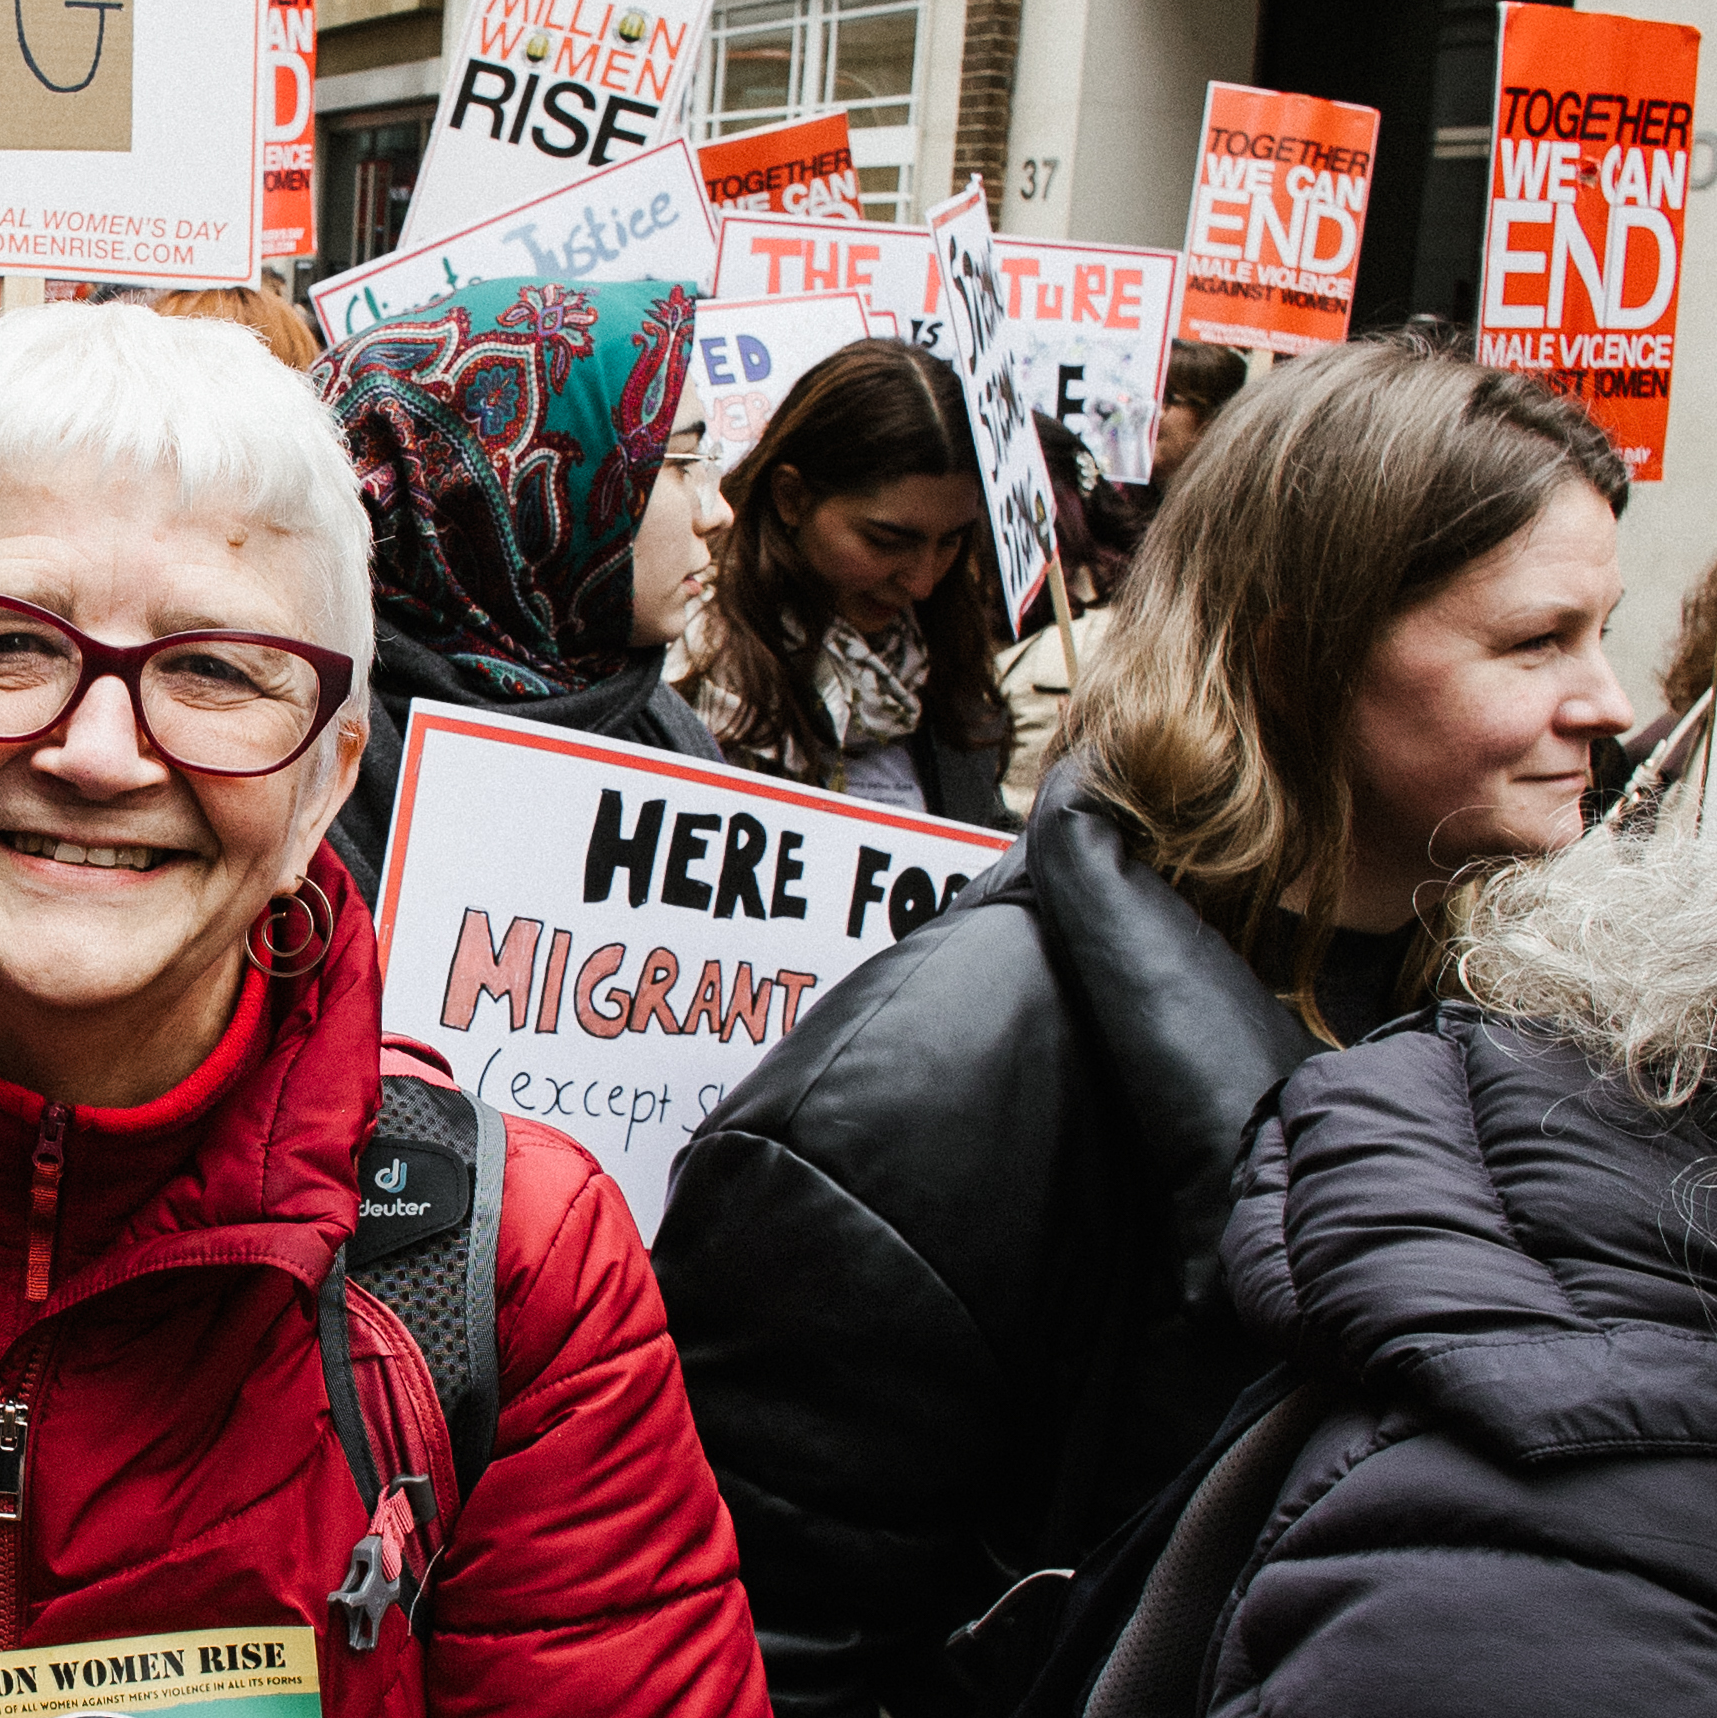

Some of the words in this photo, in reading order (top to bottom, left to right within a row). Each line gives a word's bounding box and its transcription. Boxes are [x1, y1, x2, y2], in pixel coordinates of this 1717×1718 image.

[449, 58, 660, 167] RISE
[705, 147, 852, 204] TOGETHER
[1020, 158, 1059, 201] 37
[1210, 127, 1370, 177] TOGETHER
[1500, 138, 1581, 204] WE
[1206, 153, 1276, 195] WE
[1285, 164, 1366, 212] CAN
[42, 209, 169, 239] WOMEN'S
[176, 218, 229, 243] DAY
[501, 191, 681, 278] Justice
[1190, 184, 1358, 275] END
[750, 237, 880, 306] THE
[1189, 255, 1254, 284] MALE
[1483, 197, 1678, 330] END
[1482, 333, 1556, 368] MALE
[582, 788, 808, 921] HERE
[6, 1704, 18, 1714] OF
[21, 1702, 38, 1713] ALL
[40, 1699, 79, 1711] WOMEN
[81, 1693, 126, 1707] AGAINST
[129, 1690, 159, 1702] MEN'S
[163, 1684, 211, 1697] VIOLENCE
[214, 1681, 224, 1691] IN
[228, 1679, 245, 1689] ALL
[248, 1677, 264, 1688] ITS
[266, 1675, 303, 1686] FORMS
[48, 1649, 185, 1692] WOMEN
[197, 1642, 286, 1675] RISE
